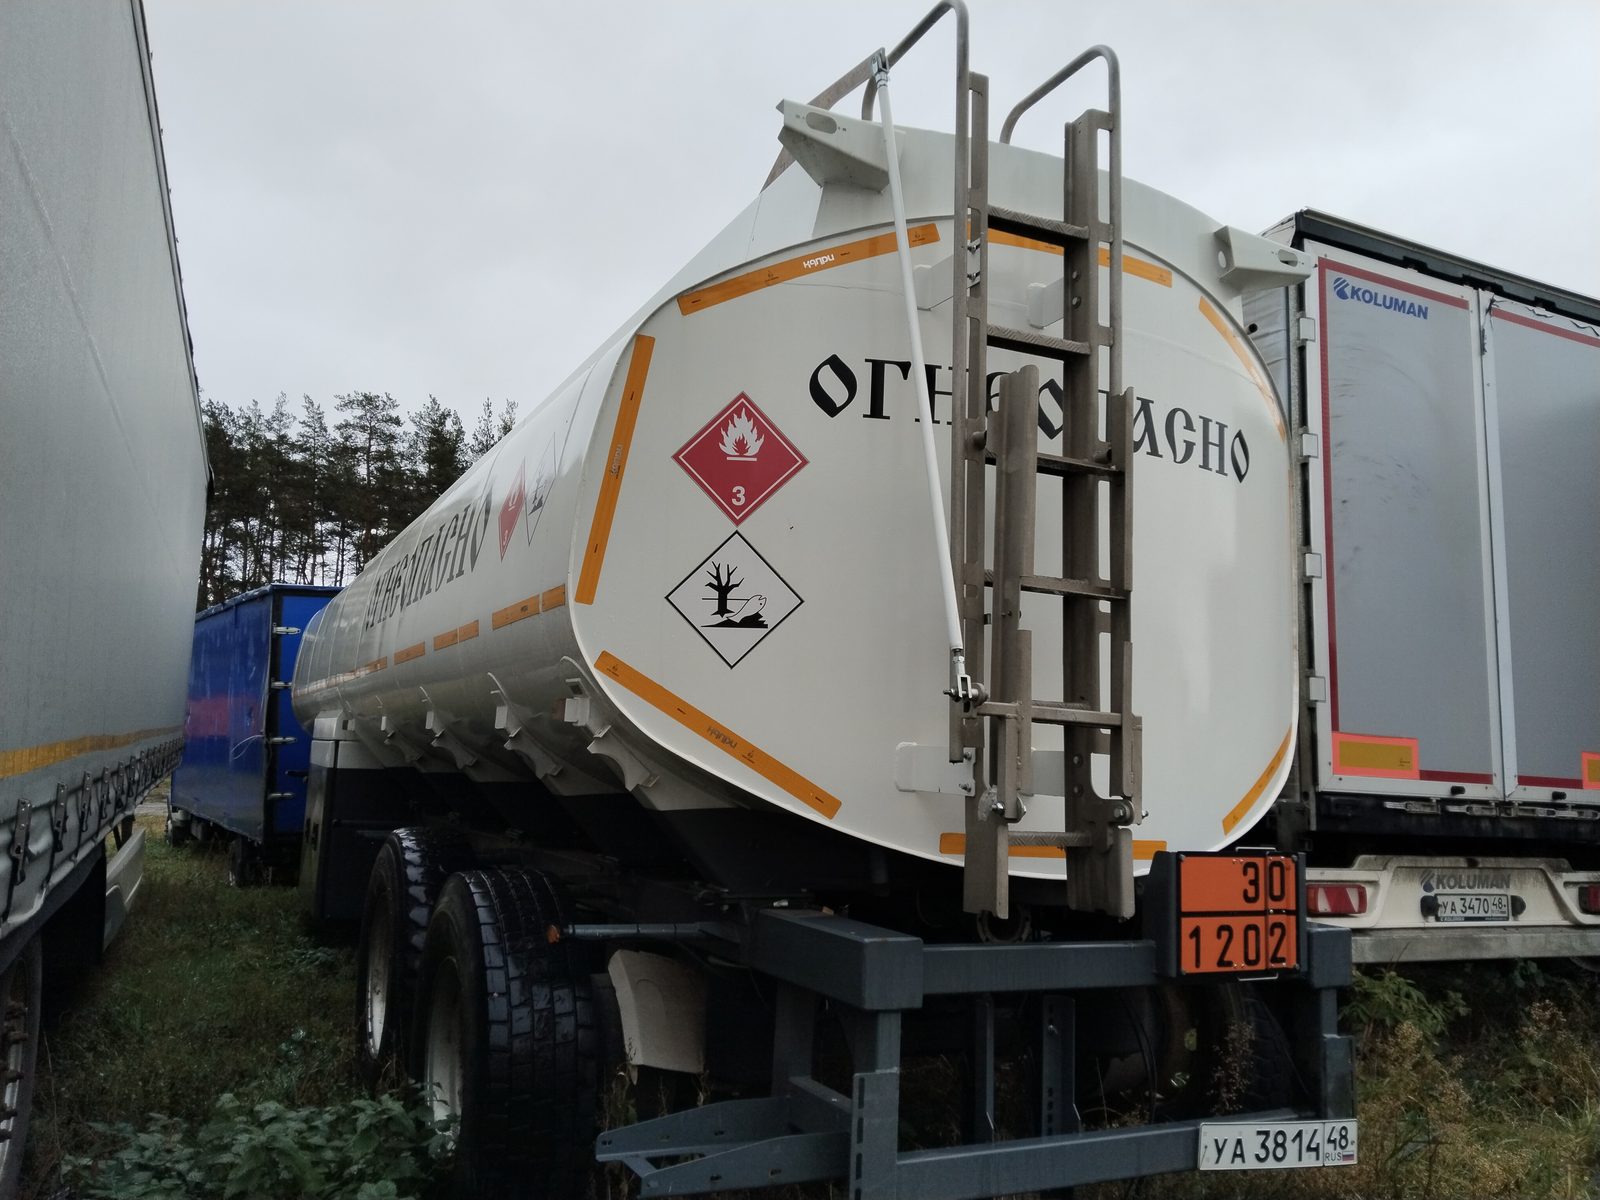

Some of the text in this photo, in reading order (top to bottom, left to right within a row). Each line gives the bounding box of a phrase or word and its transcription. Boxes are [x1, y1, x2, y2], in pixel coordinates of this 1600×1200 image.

[1350, 286, 1428, 320] KOLUMAN
[731, 486, 746, 506] 3
[1243, 861, 1285, 903] 30
[1436, 873, 1511, 890] KOLUMAN
[1460, 897, 1489, 914] 3470
[1492, 897, 1503, 910] 48
[1189, 922, 1286, 968] 1202
[1255, 1128, 1320, 1163] 3814
[1327, 1125, 1349, 1150] 48
[1325, 1151, 1342, 1161] RUS
